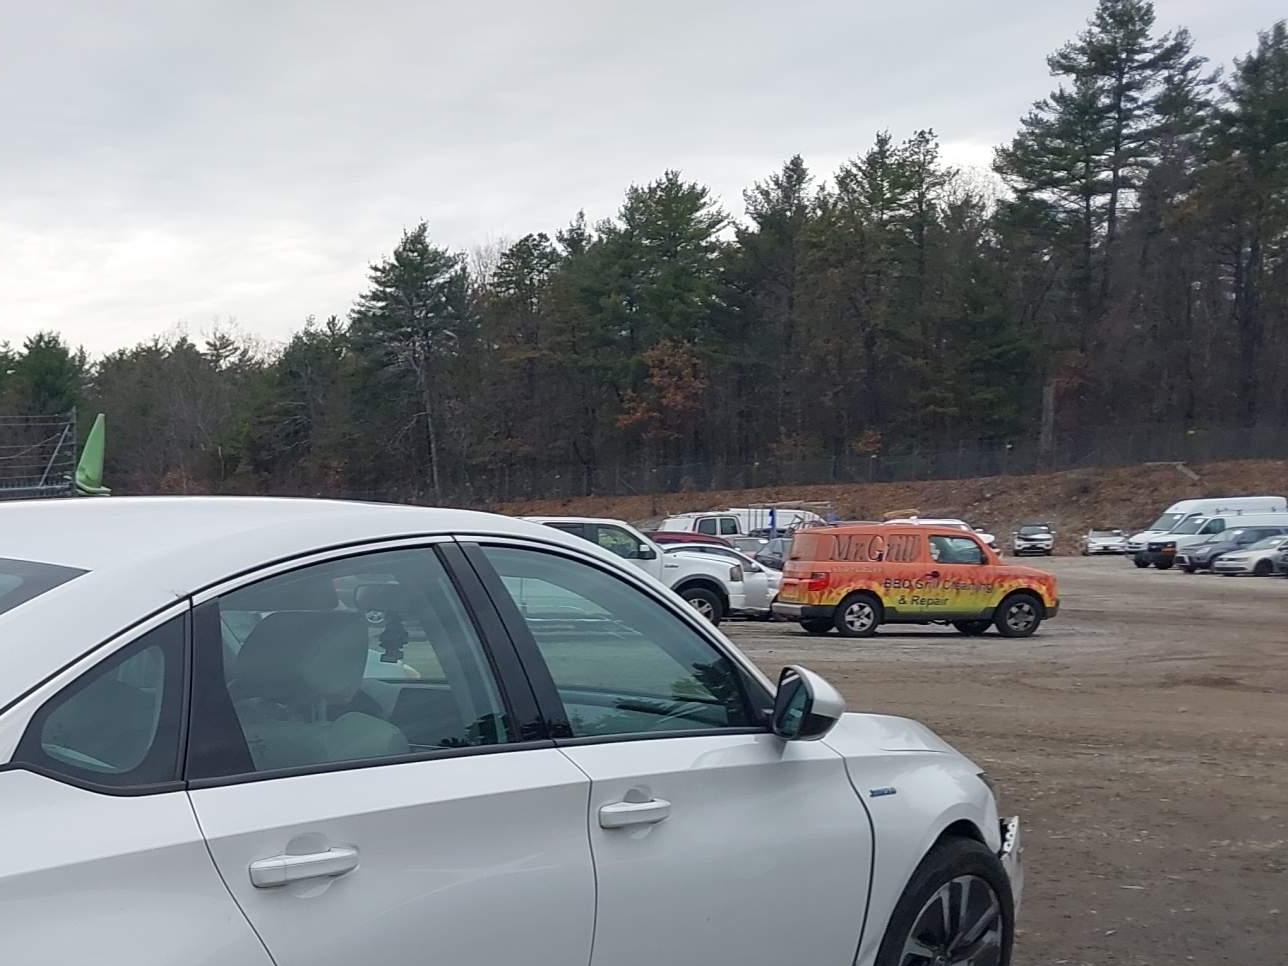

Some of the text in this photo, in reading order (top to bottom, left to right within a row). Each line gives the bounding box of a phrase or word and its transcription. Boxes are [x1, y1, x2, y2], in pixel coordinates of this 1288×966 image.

[884, 578, 913, 590] BBQ
[915, 579, 939, 590] Grill
[911, 595, 949, 607] Repair
